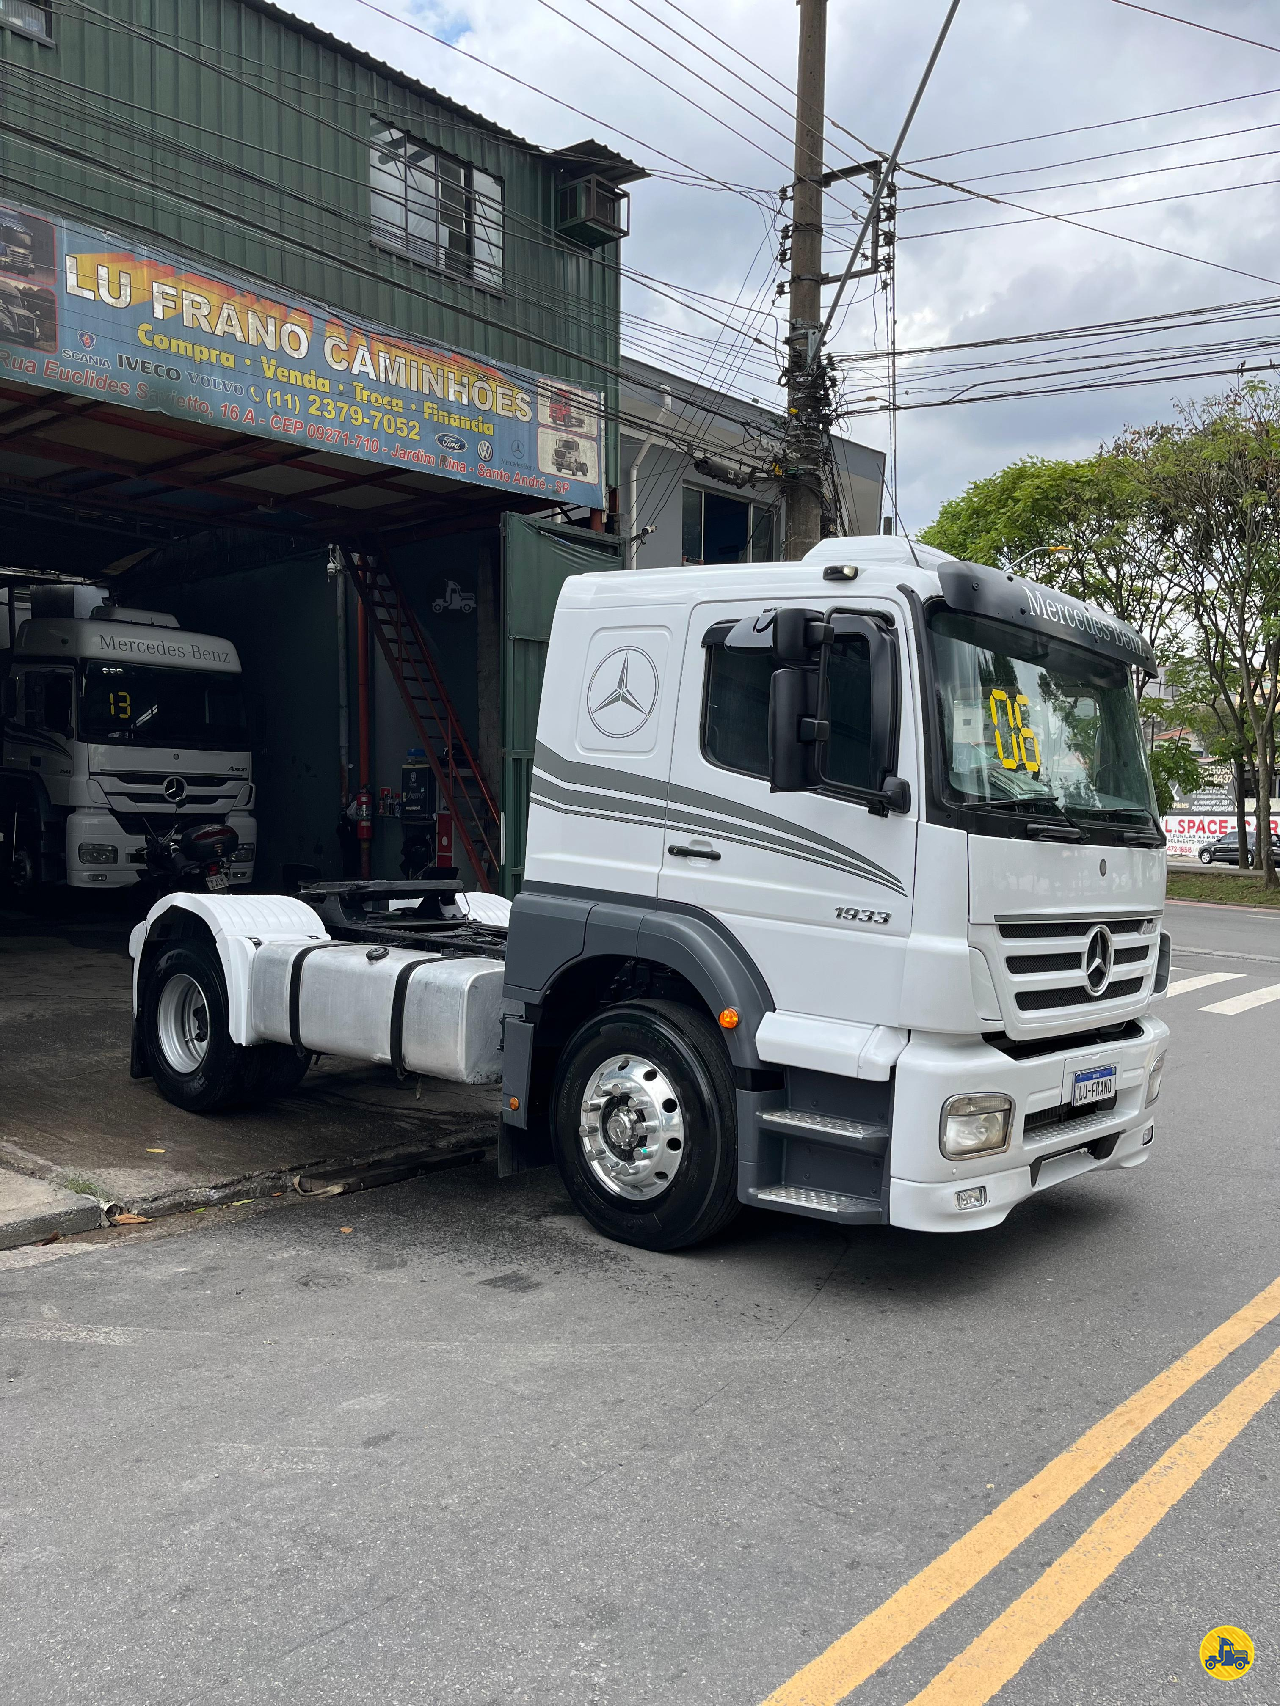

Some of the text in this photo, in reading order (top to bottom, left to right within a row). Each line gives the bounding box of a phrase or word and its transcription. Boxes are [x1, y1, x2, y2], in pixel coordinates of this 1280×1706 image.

[65, 254, 533, 422] LU FRANO CAMINHÕES
[62, 348, 111, 370] SCANIA
[117, 353, 181, 382] IVECO
[137, 323, 494, 436] Compra Venda Troca Financia
[185, 370, 244, 396] VOLVO
[0, 349, 37, 375] Rua
[43, 359, 130, 396] Euclides
[221, 402, 239, 421] 16
[242, 408, 255, 425] A
[270, 414, 304, 435] CEP
[307, 423, 379, 454] 09271-710
[391, 443, 436, 467] Jardim
[439, 454, 466, 473] Rina
[477, 463, 510, 483] Santo
[513, 473, 546, 490] André
[555, 480, 570, 495] SP
[266, 388, 421, 441] (11) 2379-7052
[98, 634, 231, 664] Mercedes-Benz
[109, 691, 131, 719] 13
[990, 688, 1041, 772] 06
[835, 907, 892, 925] 1933
